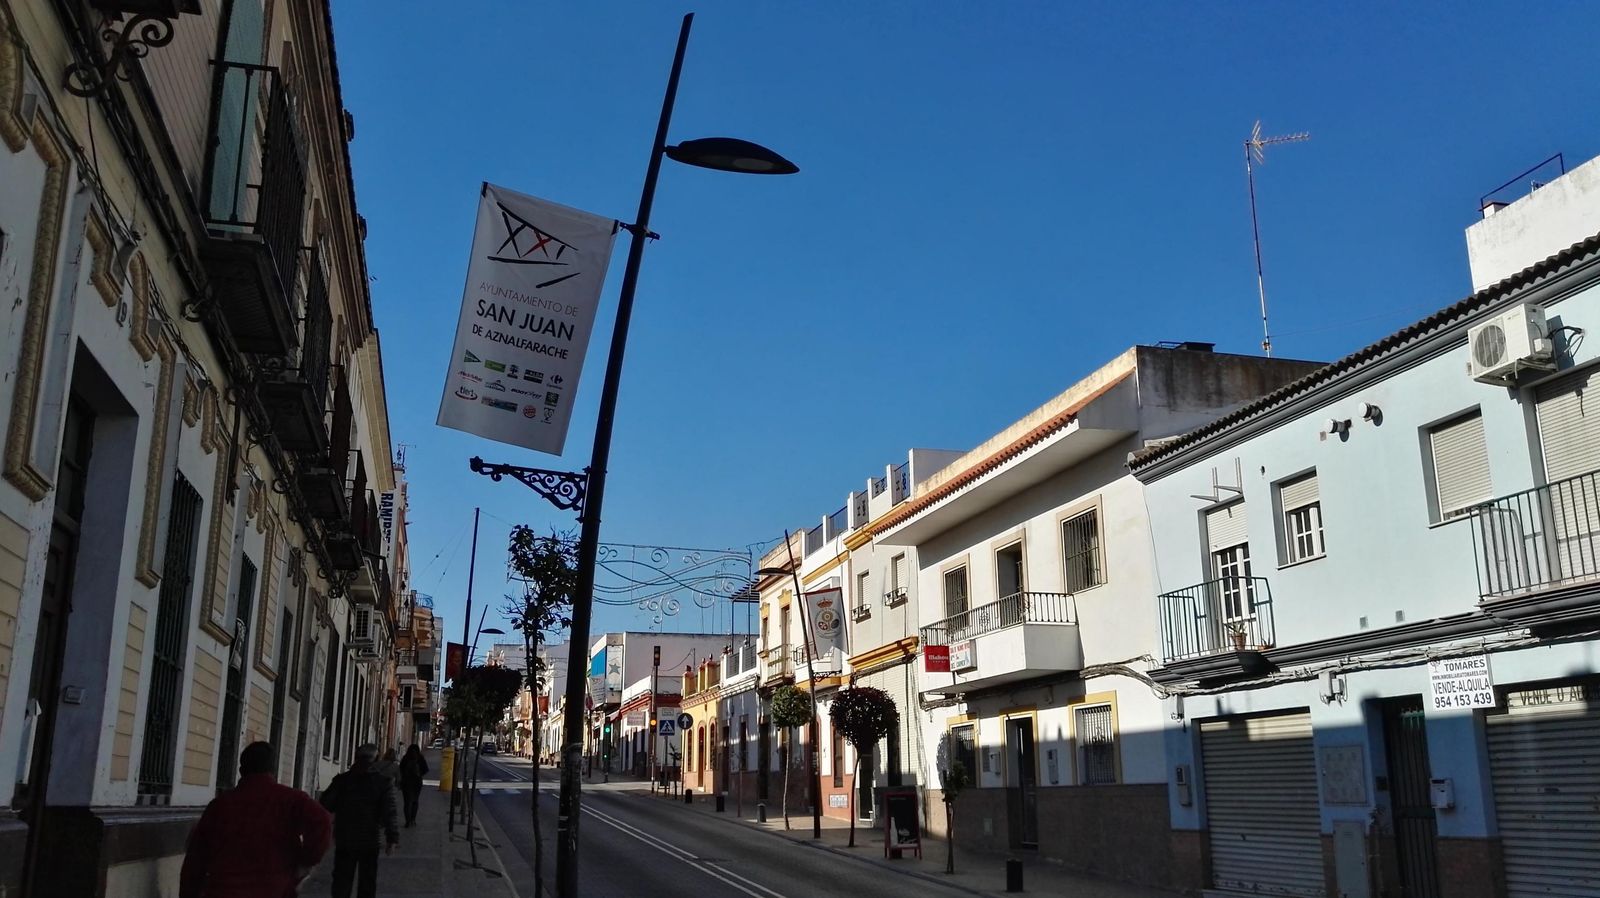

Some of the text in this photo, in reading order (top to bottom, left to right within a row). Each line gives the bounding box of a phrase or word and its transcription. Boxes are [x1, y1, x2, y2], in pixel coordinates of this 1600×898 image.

[480, 282, 579, 318] AYUNTAMIENTO DE
[476, 298, 575, 342] SAN JUAN
[472, 323, 569, 360] DE AZNALFARACHE
[1444, 658, 1486, 672] TOMARES
[1433, 677, 1490, 695] VENDE-ALQUILA
[1434, 692, 1492, 709] 954 153 439
